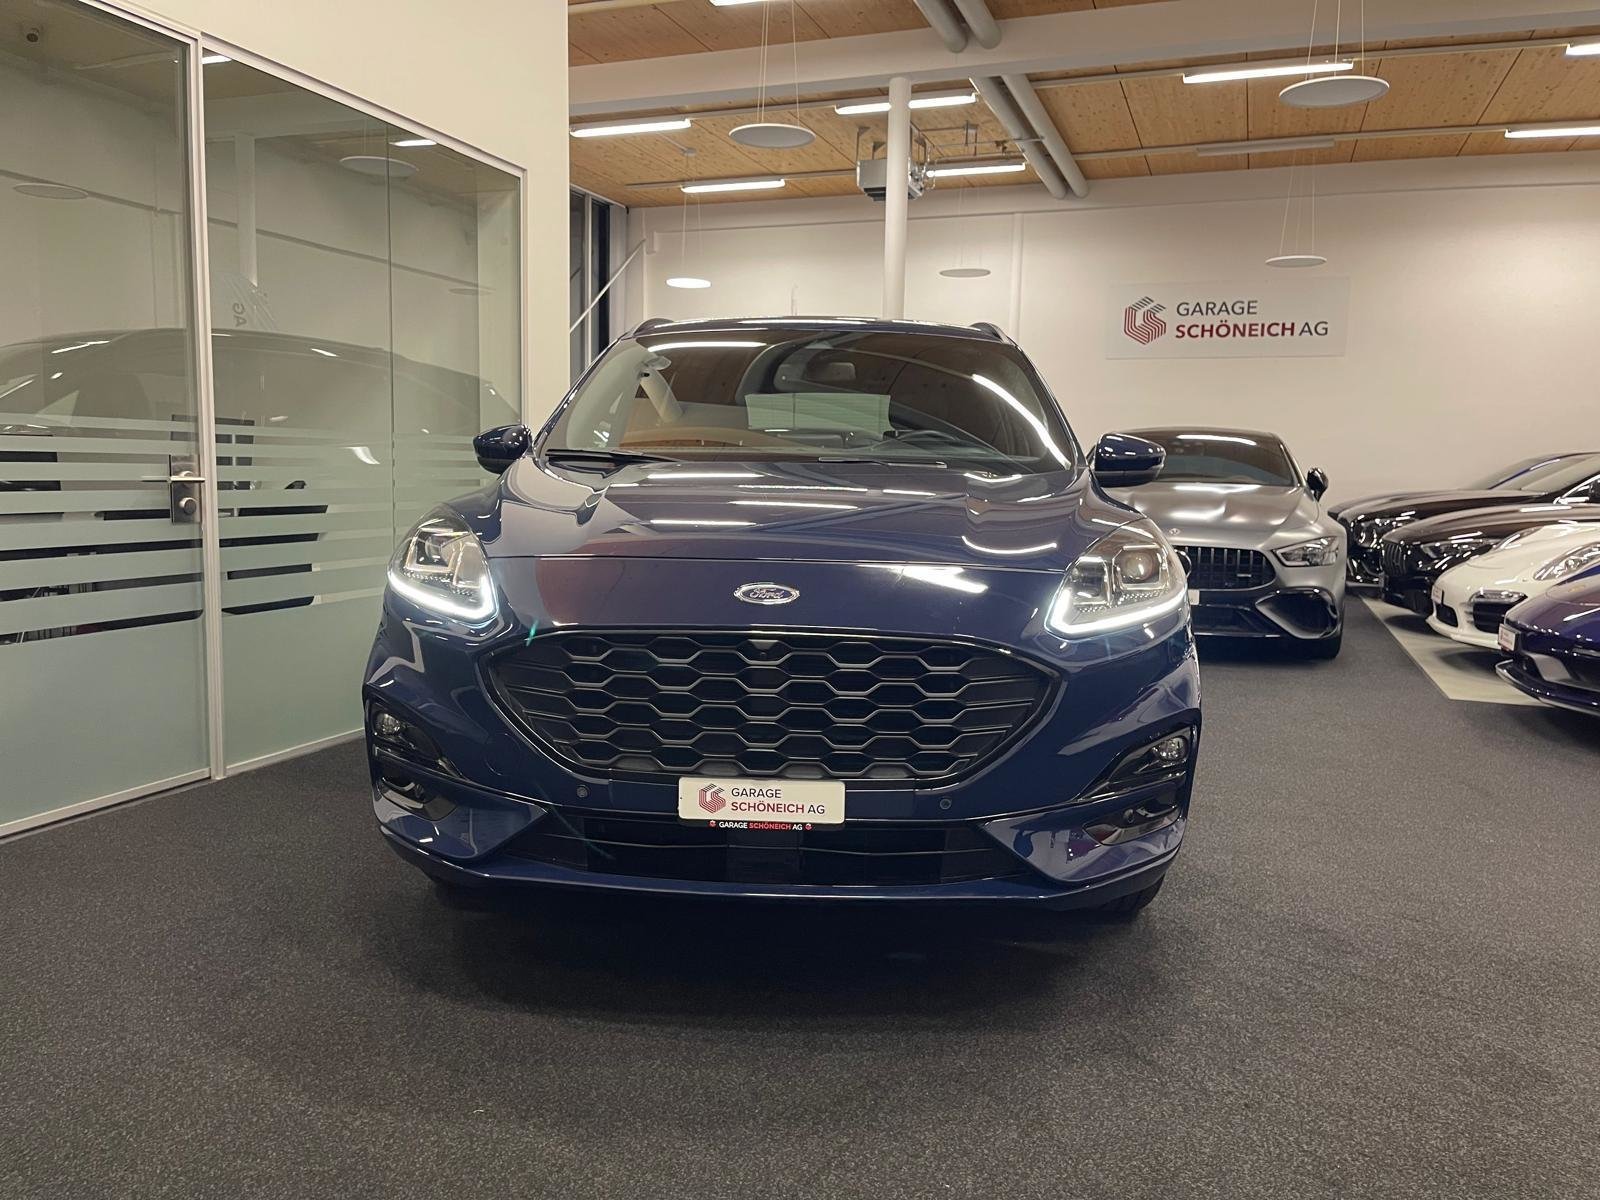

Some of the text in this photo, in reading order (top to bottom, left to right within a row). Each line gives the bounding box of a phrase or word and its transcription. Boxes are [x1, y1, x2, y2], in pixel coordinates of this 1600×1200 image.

[1176, 300, 1258, 317] GARAGE
[1175, 320, 1329, 339] SCHÖNEICH AG
[749, 588, 785, 599] Ford
[731, 787, 782, 799] GARAGE
[731, 800, 825, 815] SCHÖNEICH AG
[718, 821, 803, 831] GARAGE SCHÖNEICH AG
